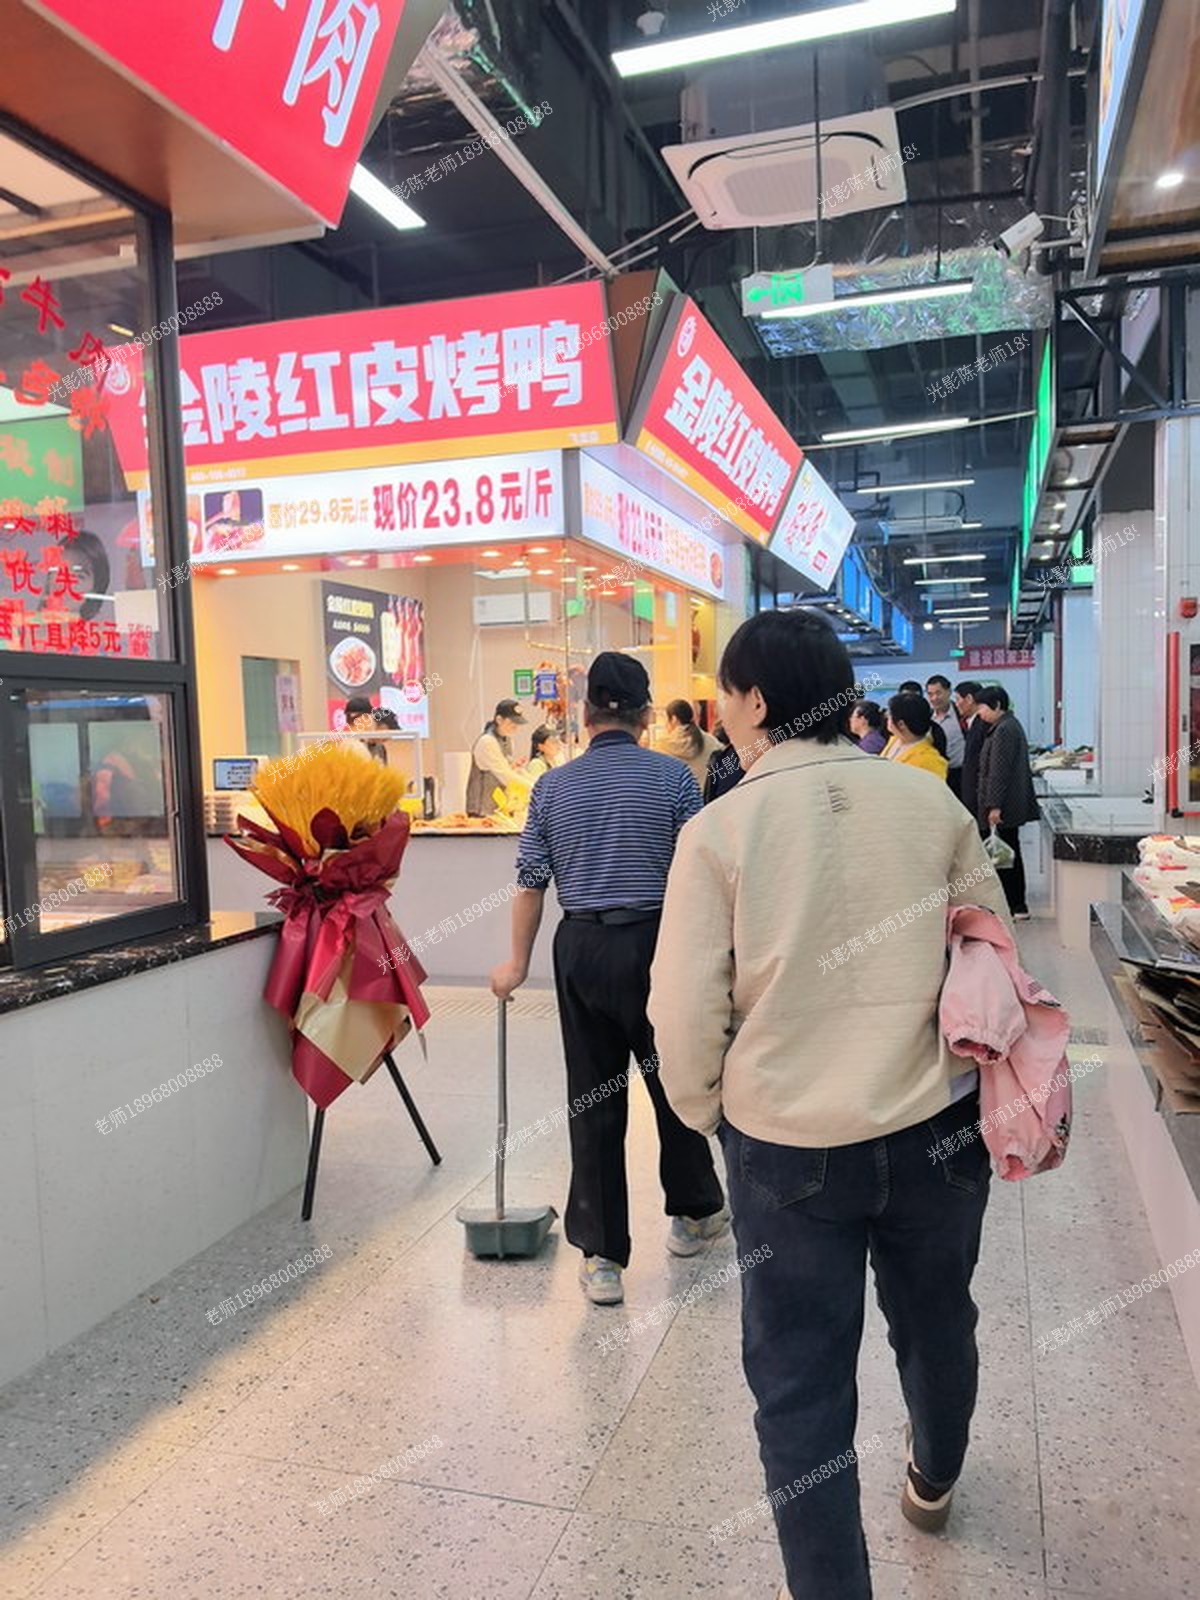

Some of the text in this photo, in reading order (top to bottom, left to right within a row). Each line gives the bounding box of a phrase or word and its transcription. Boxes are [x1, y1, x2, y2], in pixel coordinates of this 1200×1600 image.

[139, 320, 583, 449] 金陵红皮烤鸭
[373, 467, 553, 532] 现价23.8元/斤
